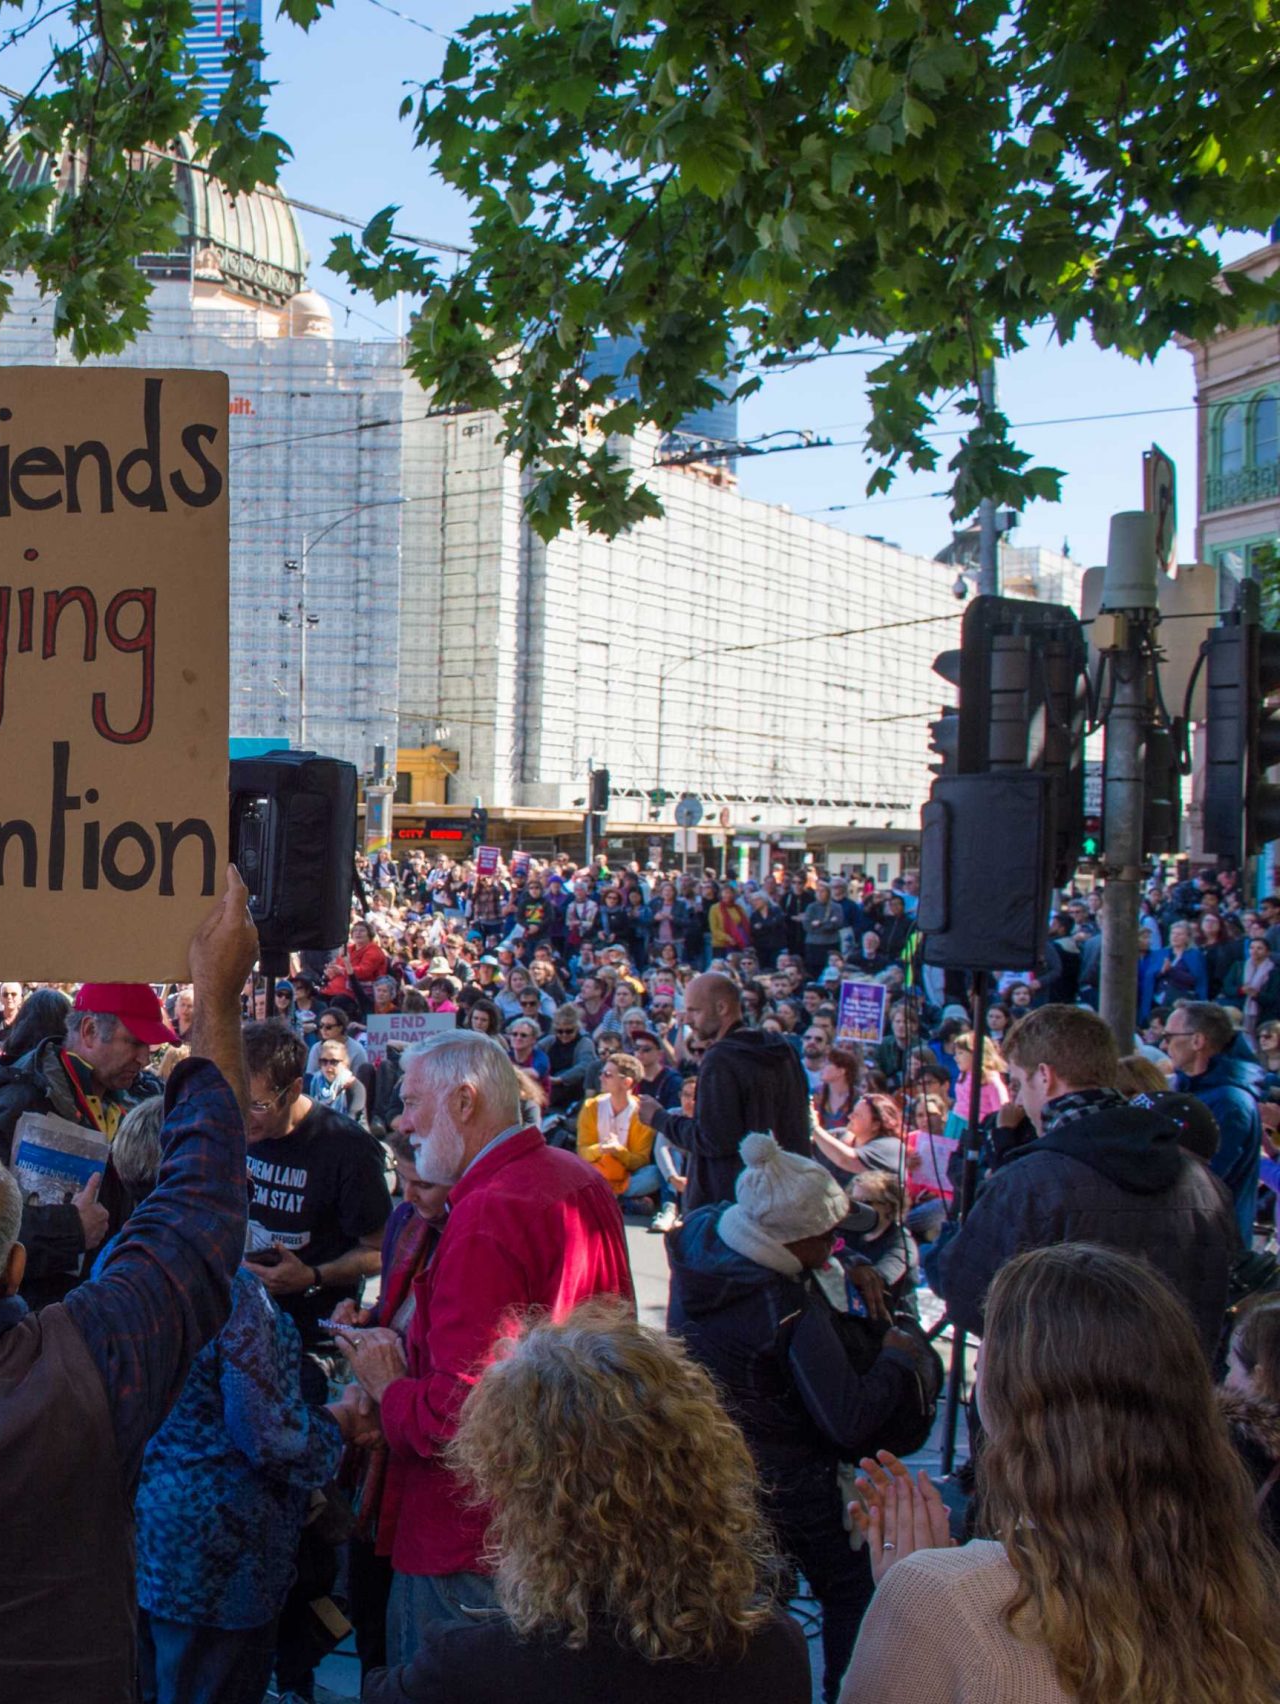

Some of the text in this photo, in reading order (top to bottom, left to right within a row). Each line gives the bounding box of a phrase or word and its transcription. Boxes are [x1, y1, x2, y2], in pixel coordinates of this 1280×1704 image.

[399, 829, 424, 839] CITY
[390, 1015, 426, 1029] END
[274, 1165, 308, 1189] LAND
[269, 1190, 305, 1213] STAY
